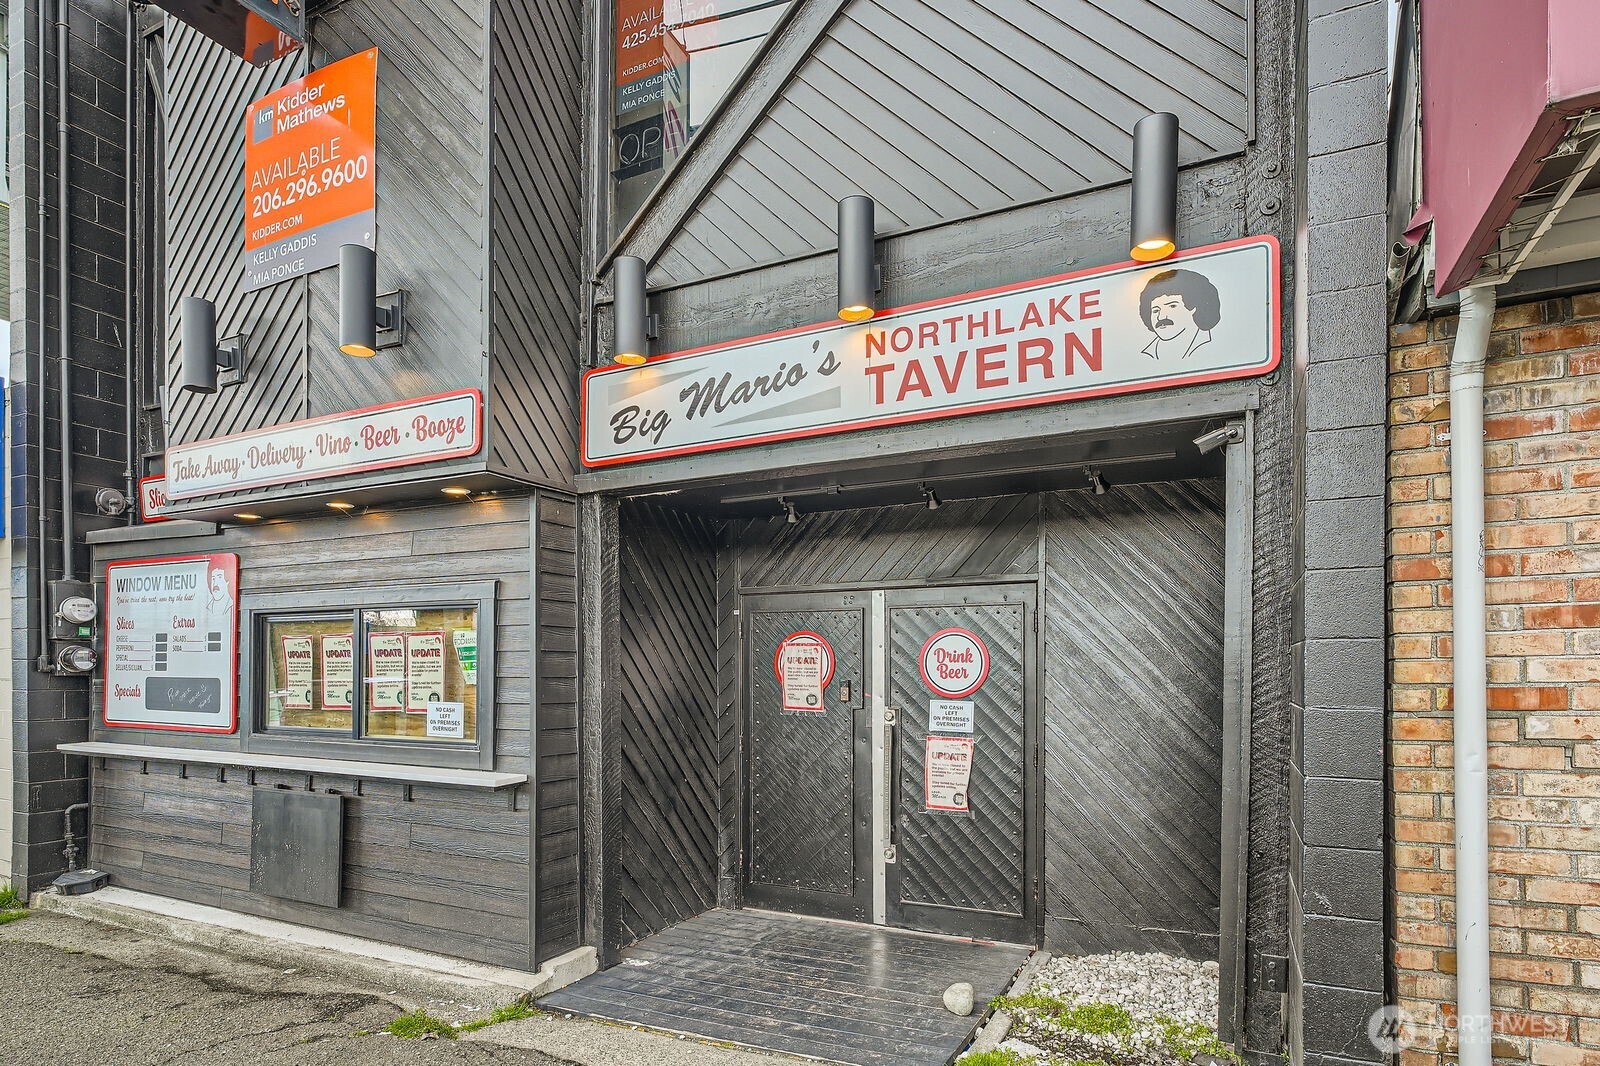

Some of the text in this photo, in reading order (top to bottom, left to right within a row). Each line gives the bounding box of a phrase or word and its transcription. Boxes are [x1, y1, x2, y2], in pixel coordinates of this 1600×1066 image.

[622, 56, 665, 77] KIDDER.COM
[622, 70, 677, 96] KELLY GADDIS
[277, 83, 326, 115] Kidder
[621, 89, 665, 110] MIA PONCE
[258, 110, 274, 125] km
[277, 95, 346, 134] Mathews
[251, 136, 341, 193] AVAILABLE
[252, 155, 369, 218] 206.296.9600
[252, 214, 304, 241] KIDDER.COM
[253, 233, 318, 266] KELLY GADDIS
[252, 258, 305, 286] MIA PONCE
[865, 289, 1103, 359] NORTHLAKE
[865, 327, 1103, 405] TAVERN
[610, 340, 841, 445] Big Mario's
[173, 414, 466, 483] Take Away Delivery Vino Beer Booze
[116, 574, 197, 593] WINDOW MENU
[116, 616, 135, 631] Slices
[172, 615, 196, 629] Extras
[287, 651, 311, 659] UPDATE
[325, 650, 352, 659] UPDATE
[374, 648, 402, 658] UPDATE
[411, 649, 441, 658] UPDATE
[786, 656, 819, 665] UPDATE
[933, 647, 974, 663] Drink
[936, 663, 969, 680] Beer
[114, 683, 141, 700] Specials
[931, 752, 968, 762] UPDATE
